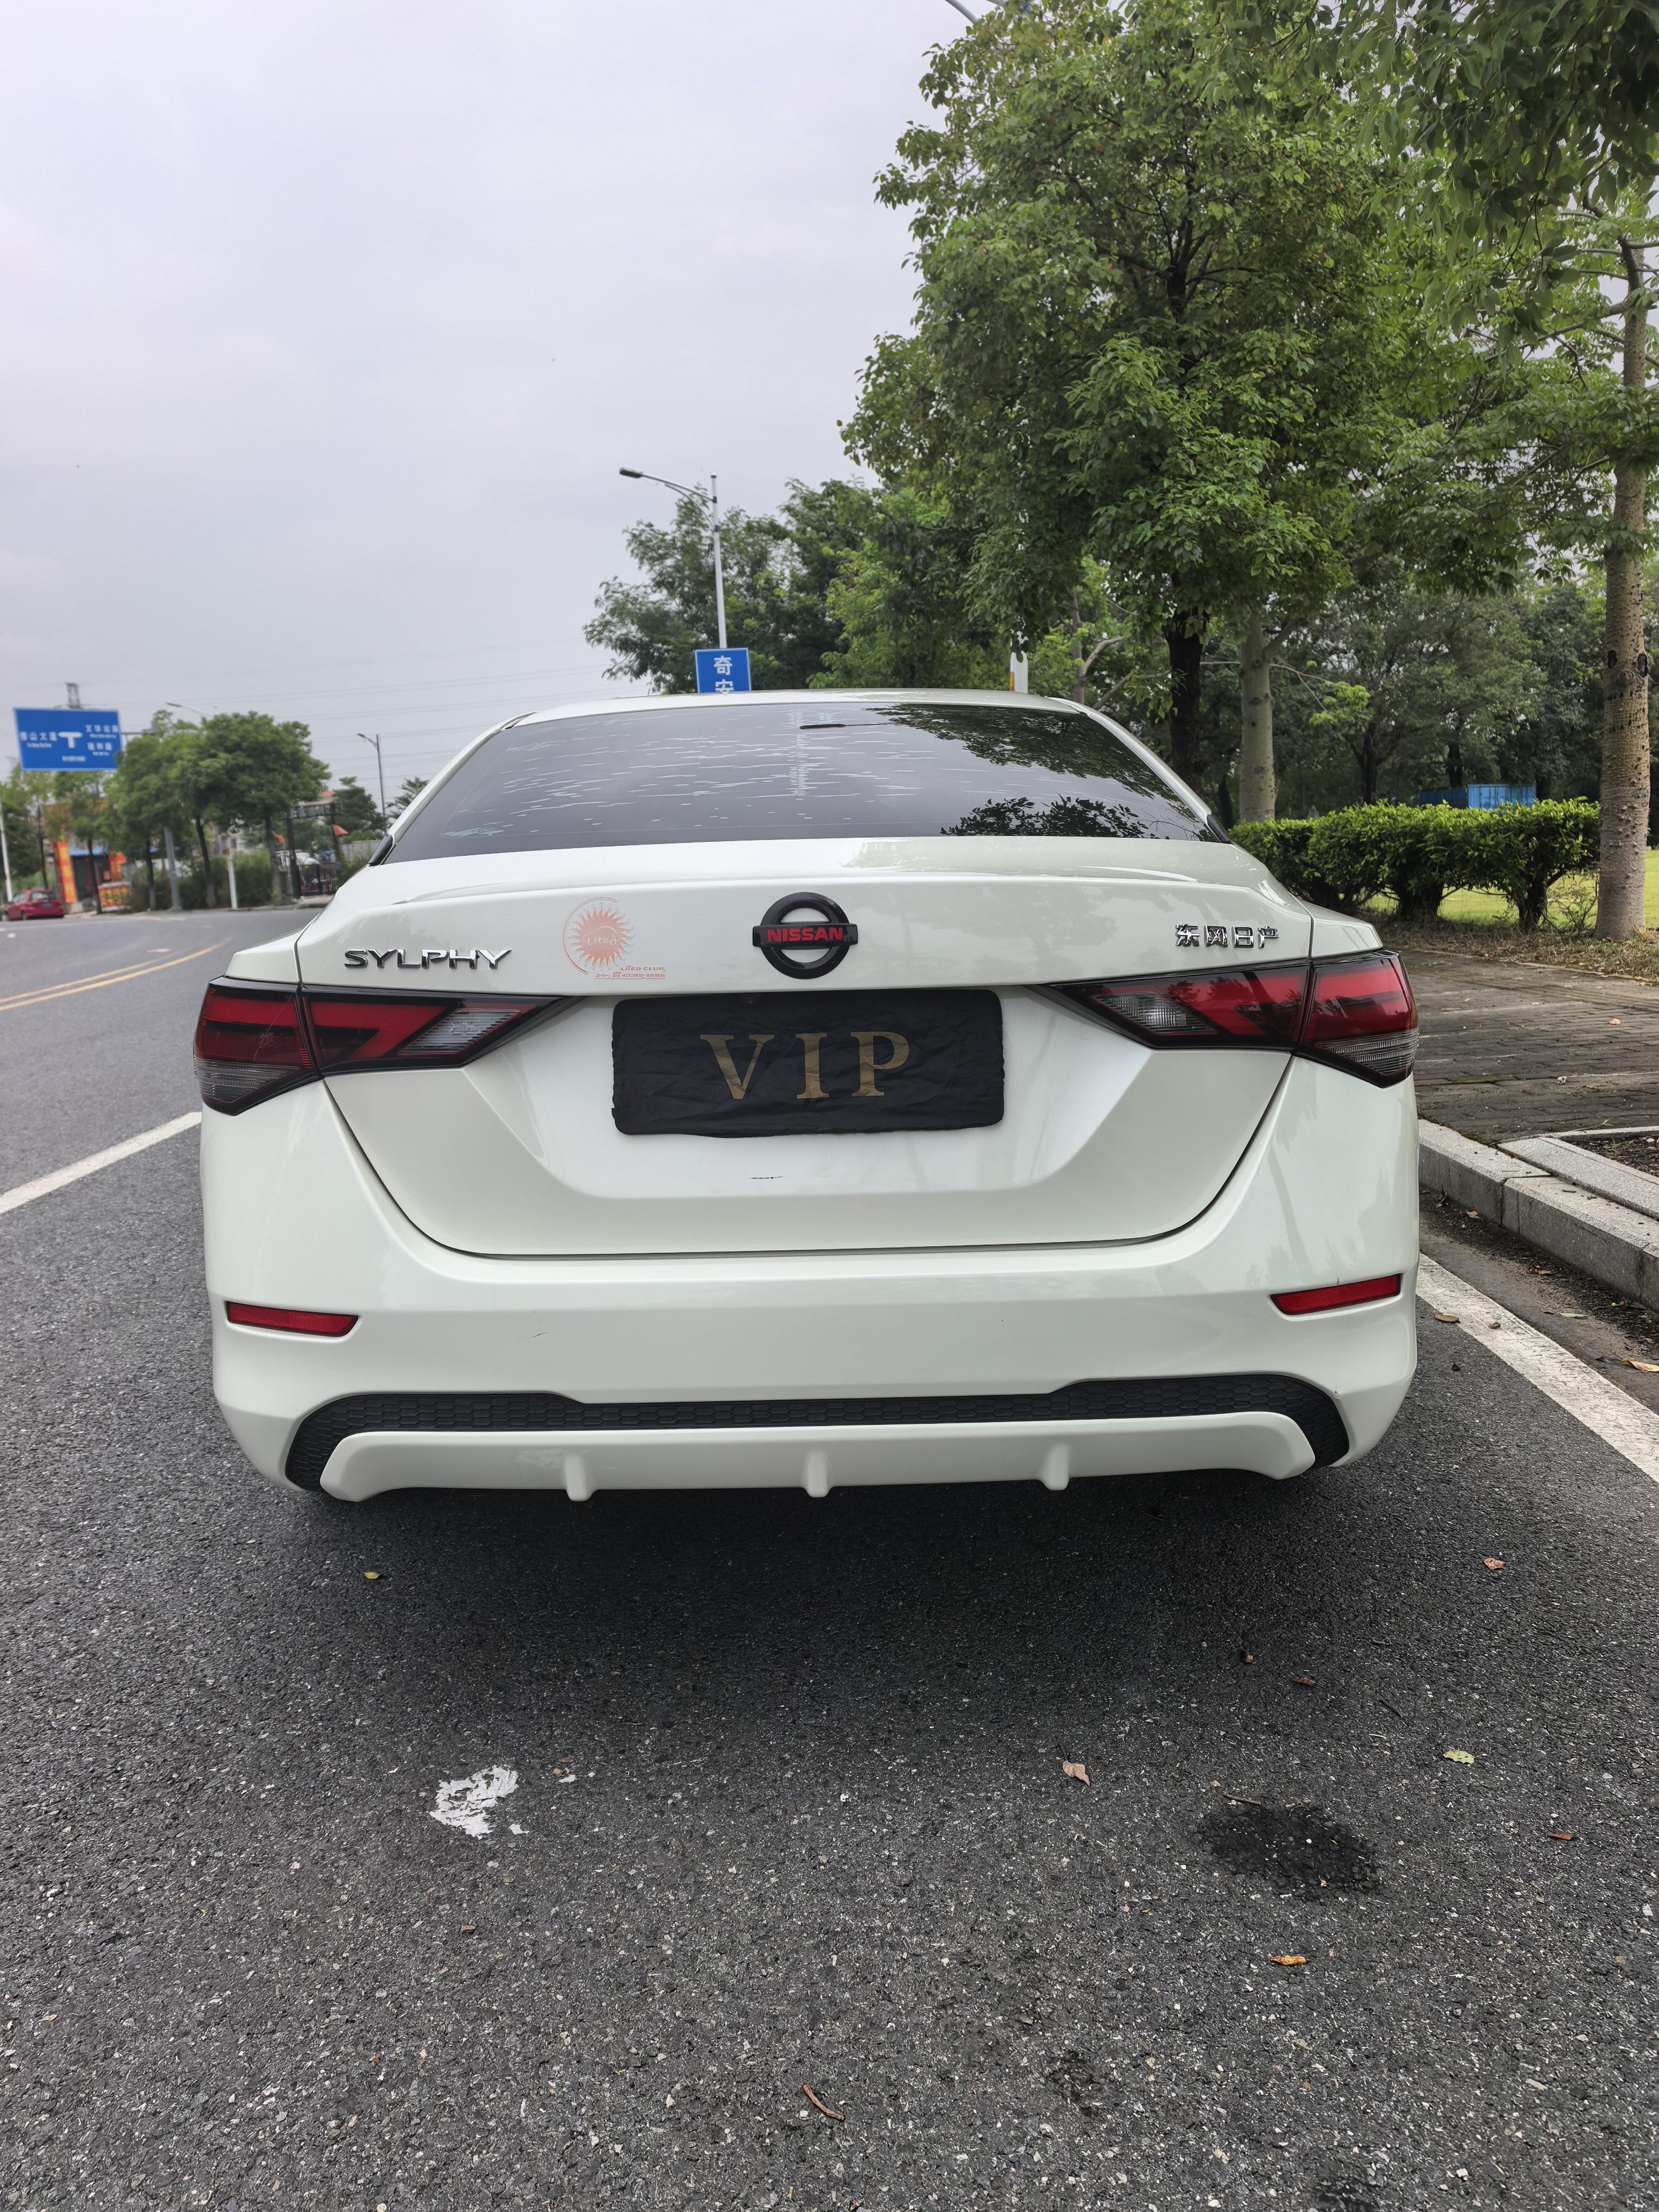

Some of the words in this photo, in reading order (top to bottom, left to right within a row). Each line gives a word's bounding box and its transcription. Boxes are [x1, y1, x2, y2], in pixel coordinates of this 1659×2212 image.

[767, 927, 844, 942] NISSAN
[1175, 923, 1280, 949] 东风日产
[343, 948, 512, 969] SYLPHY
[700, 1031, 909, 1100] VIP
